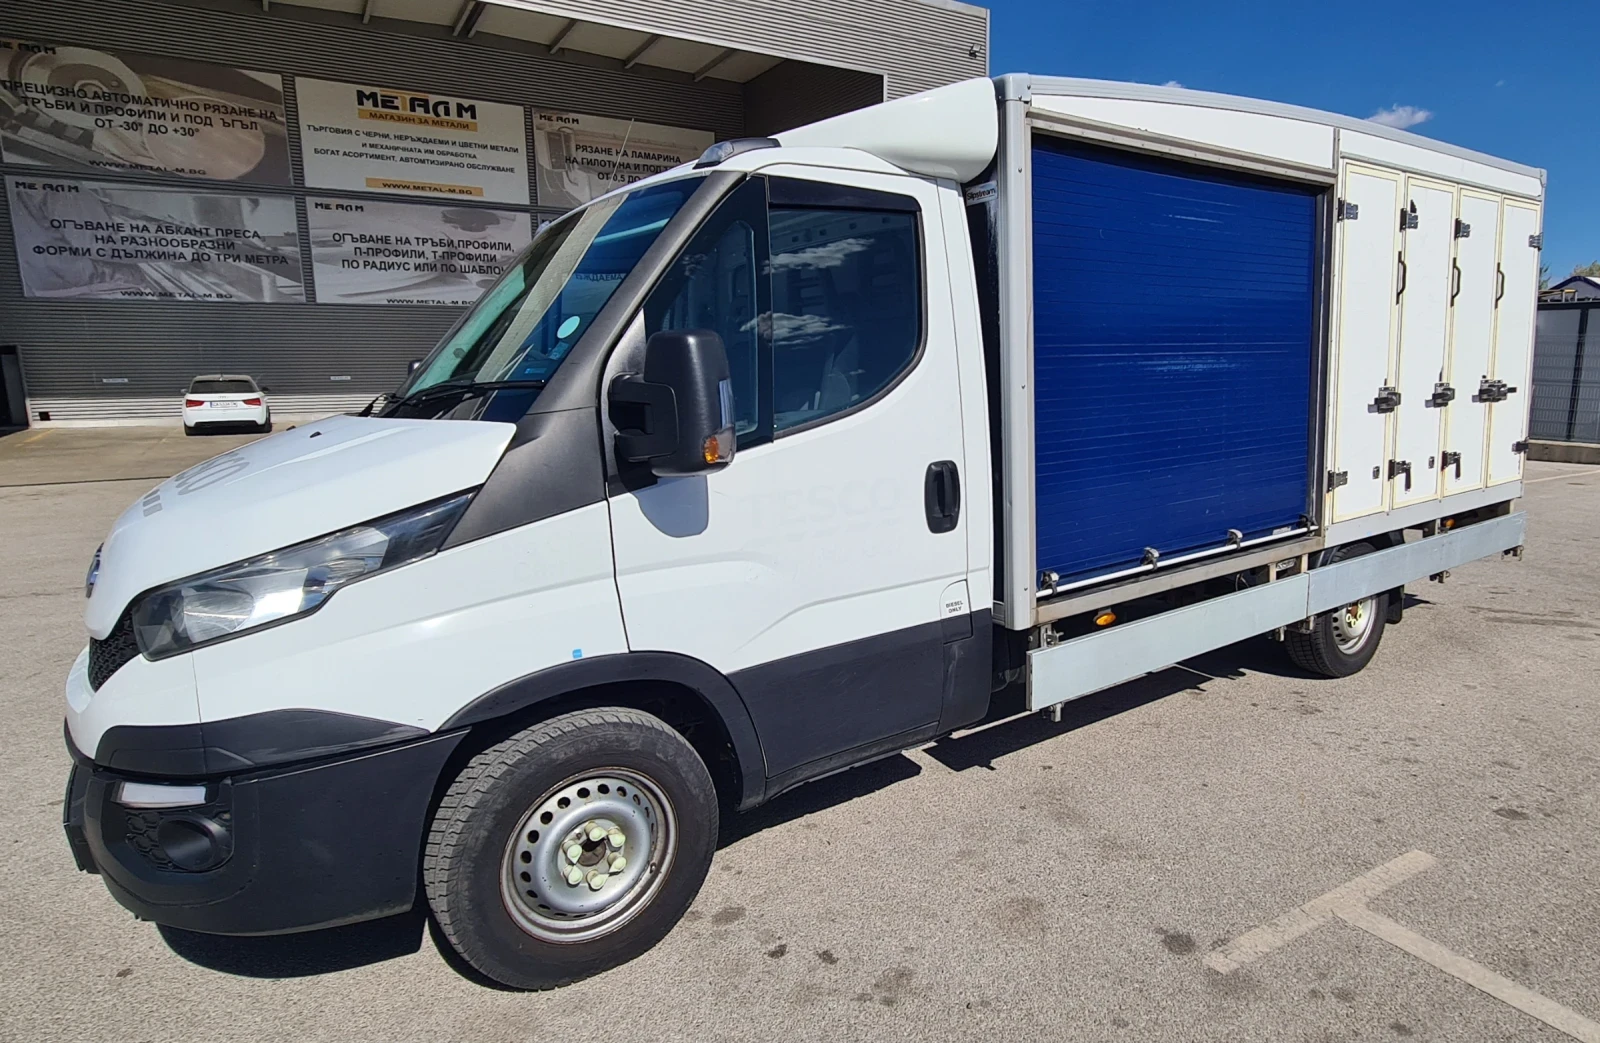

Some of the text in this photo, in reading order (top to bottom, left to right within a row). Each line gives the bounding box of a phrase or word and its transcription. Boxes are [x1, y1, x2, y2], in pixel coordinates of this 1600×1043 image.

[1, 80, 278, 120] ПРЕЦИЗНО АВТОМАТИЧНО РЯЗАНЕ НА
[22, 96, 258, 131] ТРЪБИ И ПРОФИЛИ И ПОД ЪГЪЛ
[369, 112, 469, 130] МАГАЗИН ЗА МЕТАЛИ
[94, 117, 114, 129] ОТ
[148, 124, 169, 136] ДО
[307, 124, 353, 136] ТЪРГОВИЯ
[394, 134, 450, 146] НЕРЪЖДАЕМИ
[458, 141, 488, 151] ЦВЕТНИ
[490, 144, 519, 154] МЕТАЛИ
[369, 142, 422, 154] МЕХАНИЧНАТА
[436, 149, 477, 160] ОБРАБОТКА
[575, 145, 682, 163] РЯЗАНЕ НА ЛАМАРИНА
[314, 147, 340, 157] БОГАТ
[466, 162, 516, 174] ОБСЛУЖВАНЕ
[565, 155, 579, 164] НА
[634, 163, 641, 171] И
[50, 218, 261, 240] ОГЪВАНЕ НА АБКАНТ ПРЕСА
[95, 234, 235, 250] НА РАЗНООБРАЗНИ
[332, 232, 392, 245] ОГЪВАНЕ
[395, 237, 411, 245] НА
[33, 245, 289, 265] ФОРМИ С ДЪЛЖИНА ДО ТРИ МЕТРА
[432, 251, 497, 262] Т-ПРОФИЛИ
[342, 259, 505, 275] ПО РАДИУС ИЛИ ПО ШАБЛО
[946, 600, 963, 608] DIESEL
